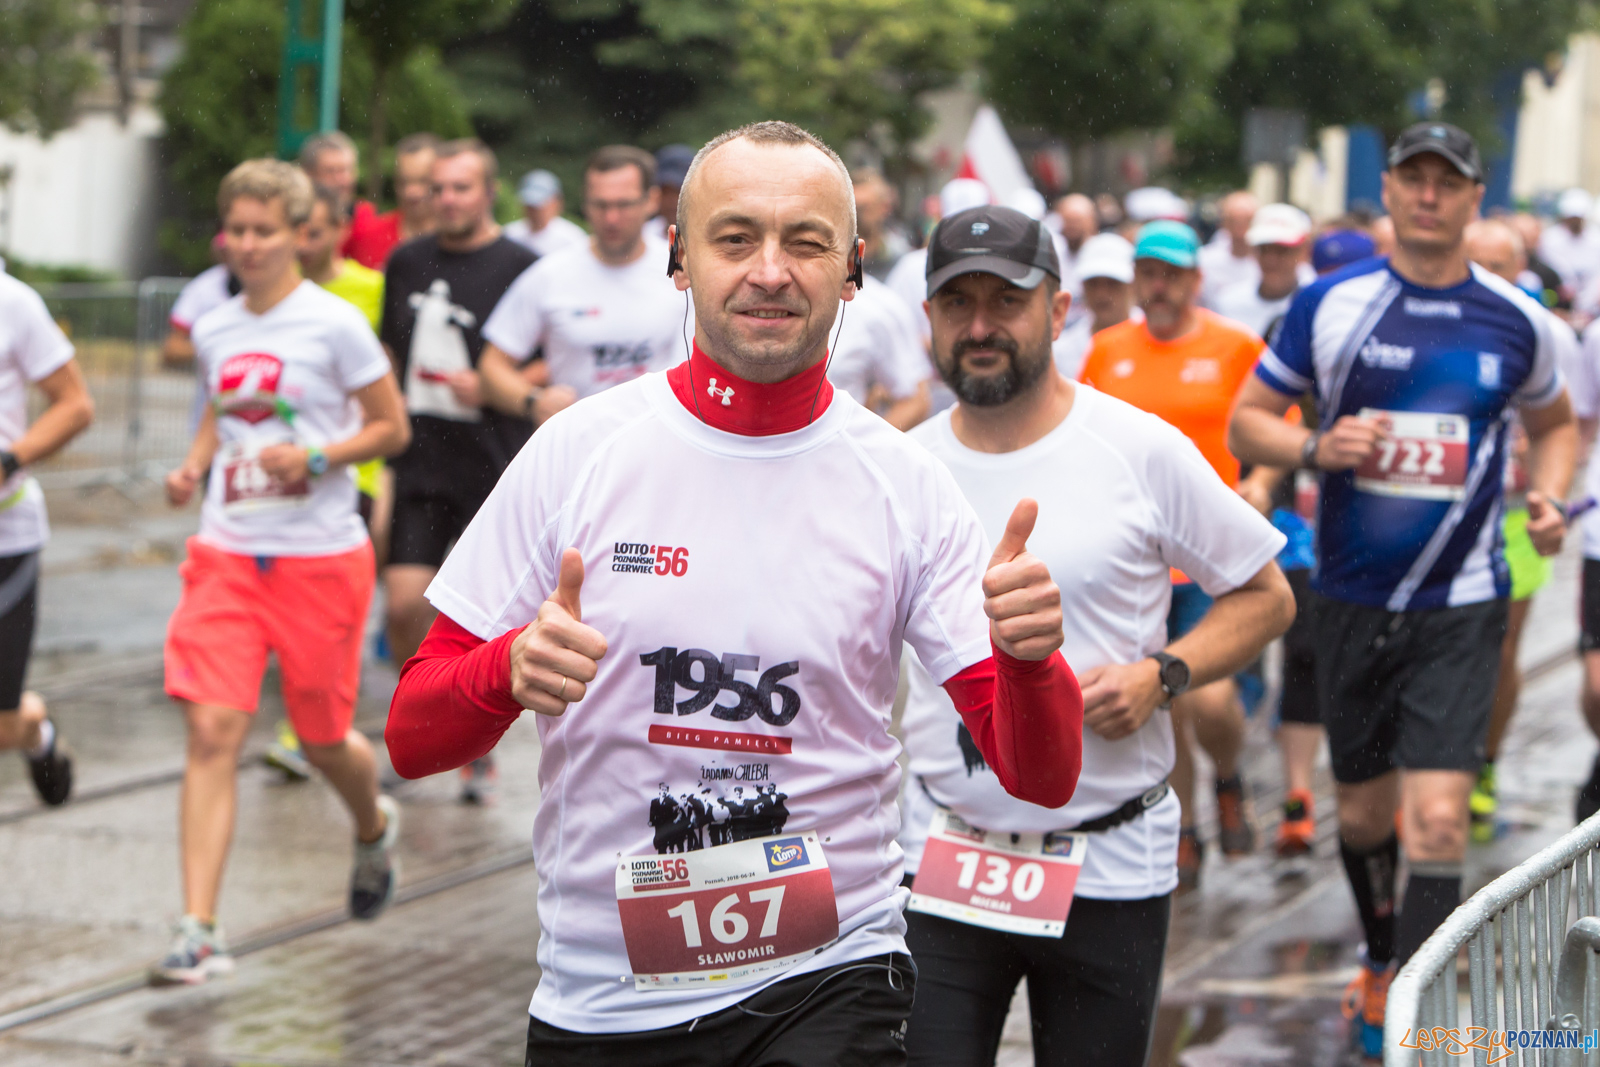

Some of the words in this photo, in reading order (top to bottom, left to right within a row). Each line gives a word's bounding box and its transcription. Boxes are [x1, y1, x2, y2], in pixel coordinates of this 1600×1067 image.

[1376, 439, 1445, 475] 722
[614, 542, 649, 555] LOTTO
[613, 554, 655, 565] POZNAŃSKI
[611, 563, 654, 574] CZERWIEC
[639, 646, 801, 727] 1956
[666, 731, 701, 742] BIEG
[713, 736, 778, 748] PAMIĘCI
[735, 763, 769, 781] CHLEBA
[776, 847, 797, 862] LOTTO
[631, 860, 657, 870] LOTTO
[632, 875, 664, 884] CZERWIEC
[955, 851, 1045, 902] 130
[667, 885, 786, 948] 167
[697, 944, 776, 966] SŁAWOMIR
